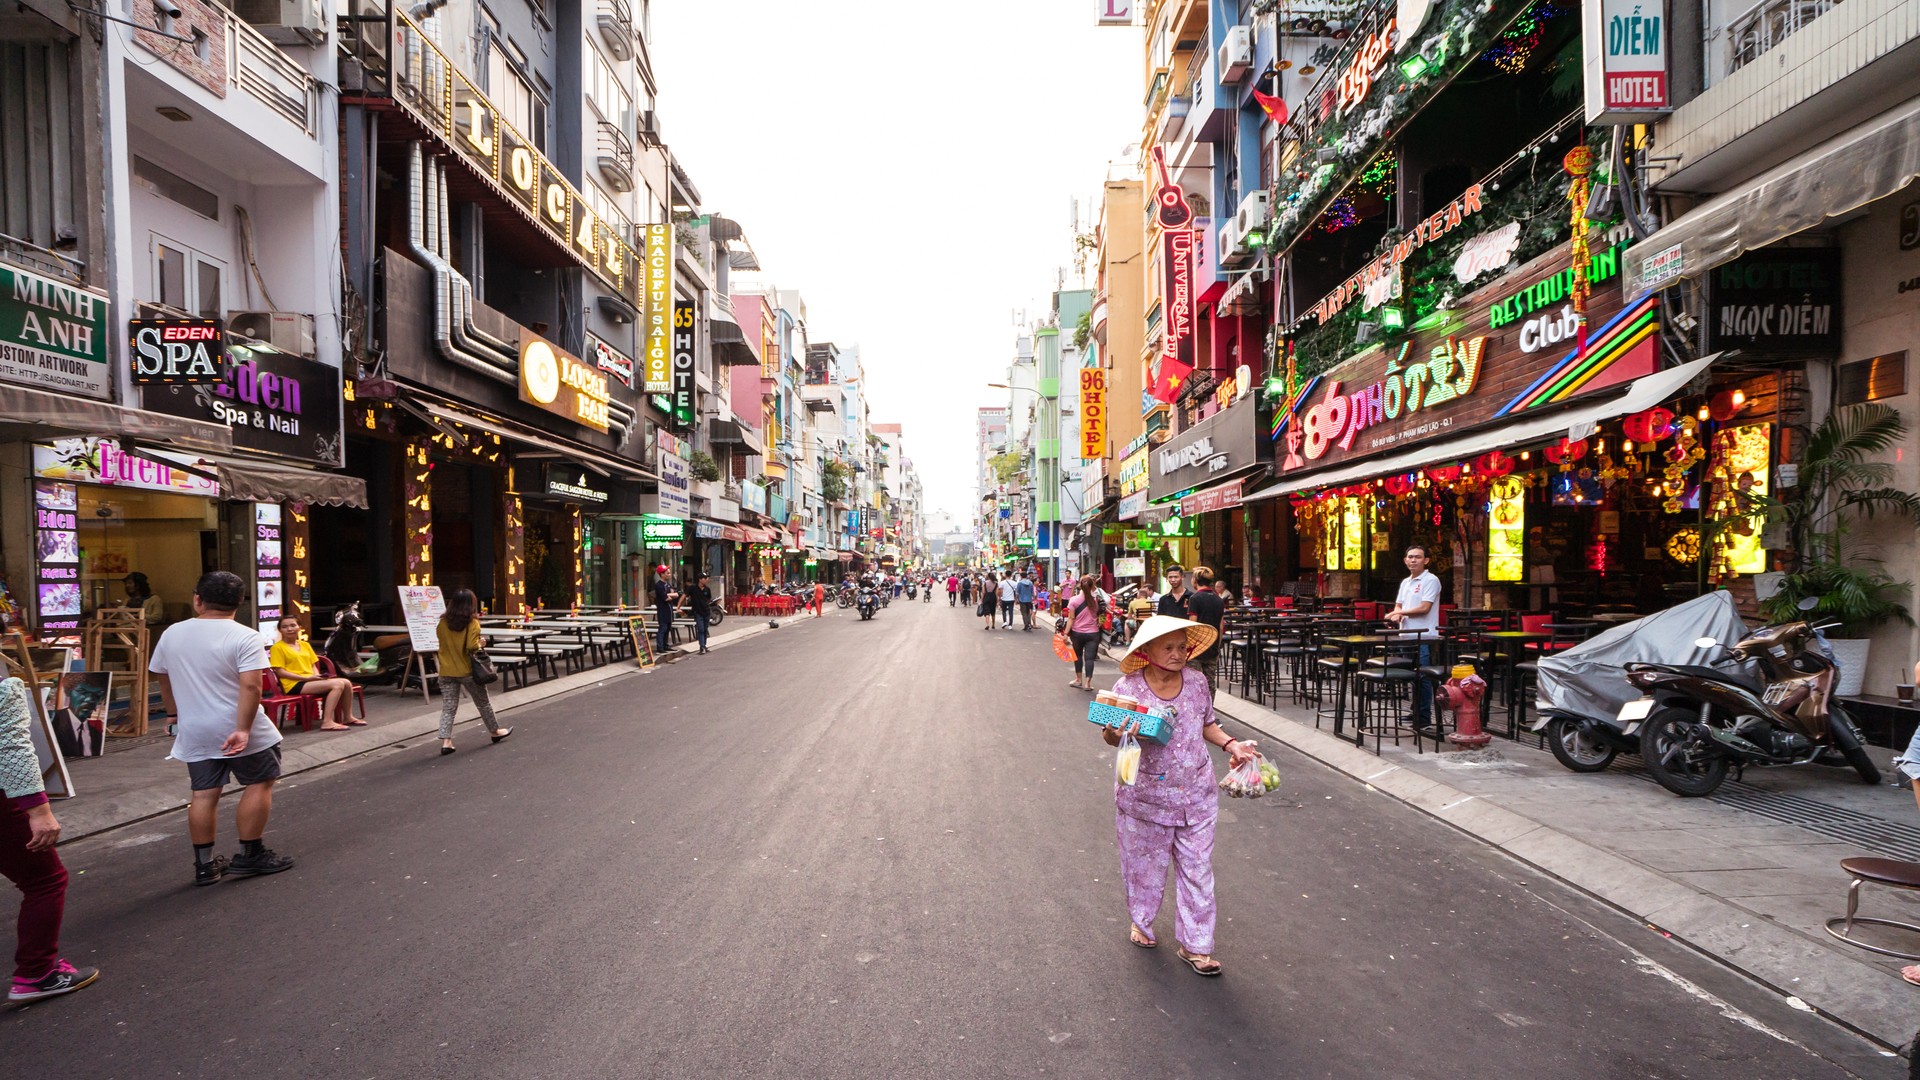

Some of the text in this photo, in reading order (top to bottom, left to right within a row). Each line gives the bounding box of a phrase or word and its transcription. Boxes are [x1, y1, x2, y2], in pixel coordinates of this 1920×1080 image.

[1609, 5, 1660, 55] DIỄM
[1338, 18, 1397, 116] Tiger
[1610, 76, 1663, 103] HOTEL
[467, 99, 621, 275] LOCAL
[651, 225, 665, 311] GRACEFUL
[1318, 274, 1365, 325] HAPPY
[1414, 183, 1483, 248] YEAR
[1720, 262, 1828, 290] HOTEL
[13, 271, 95, 322] MINH
[1171, 233, 1191, 339] UNIVERSAL
[18, 310, 94, 356] ANH
[164, 327, 215, 340] EDEN
[674, 308, 693, 328] 65
[1519, 305, 1580, 353] Club
[1720, 292, 1830, 343] NGỌC DIỄM
[39, 353, 88, 377] ARTWORK
[651, 315, 665, 381] SAIGON
[213, 353, 301, 415] Eden
[561, 356, 610, 403] LOCAL
[645, 381, 670, 391] HOTEL
[675, 334, 692, 426] HOTEL
[1081, 370, 1104, 391] 96
[1216, 377, 1237, 408] Tiger
[213, 400, 248, 426] Spa
[253, 410, 265, 428] &
[269, 414, 299, 436] Nail
[577, 392, 610, 428] BAR
[1085, 393, 1101, 456] HOTEL
[1304, 381, 1349, 459] 86
[99, 442, 171, 487] Eden
[38, 509, 76, 530] Eden
[257, 525, 279, 540] Spa
[41, 568, 77, 579] NAILS
